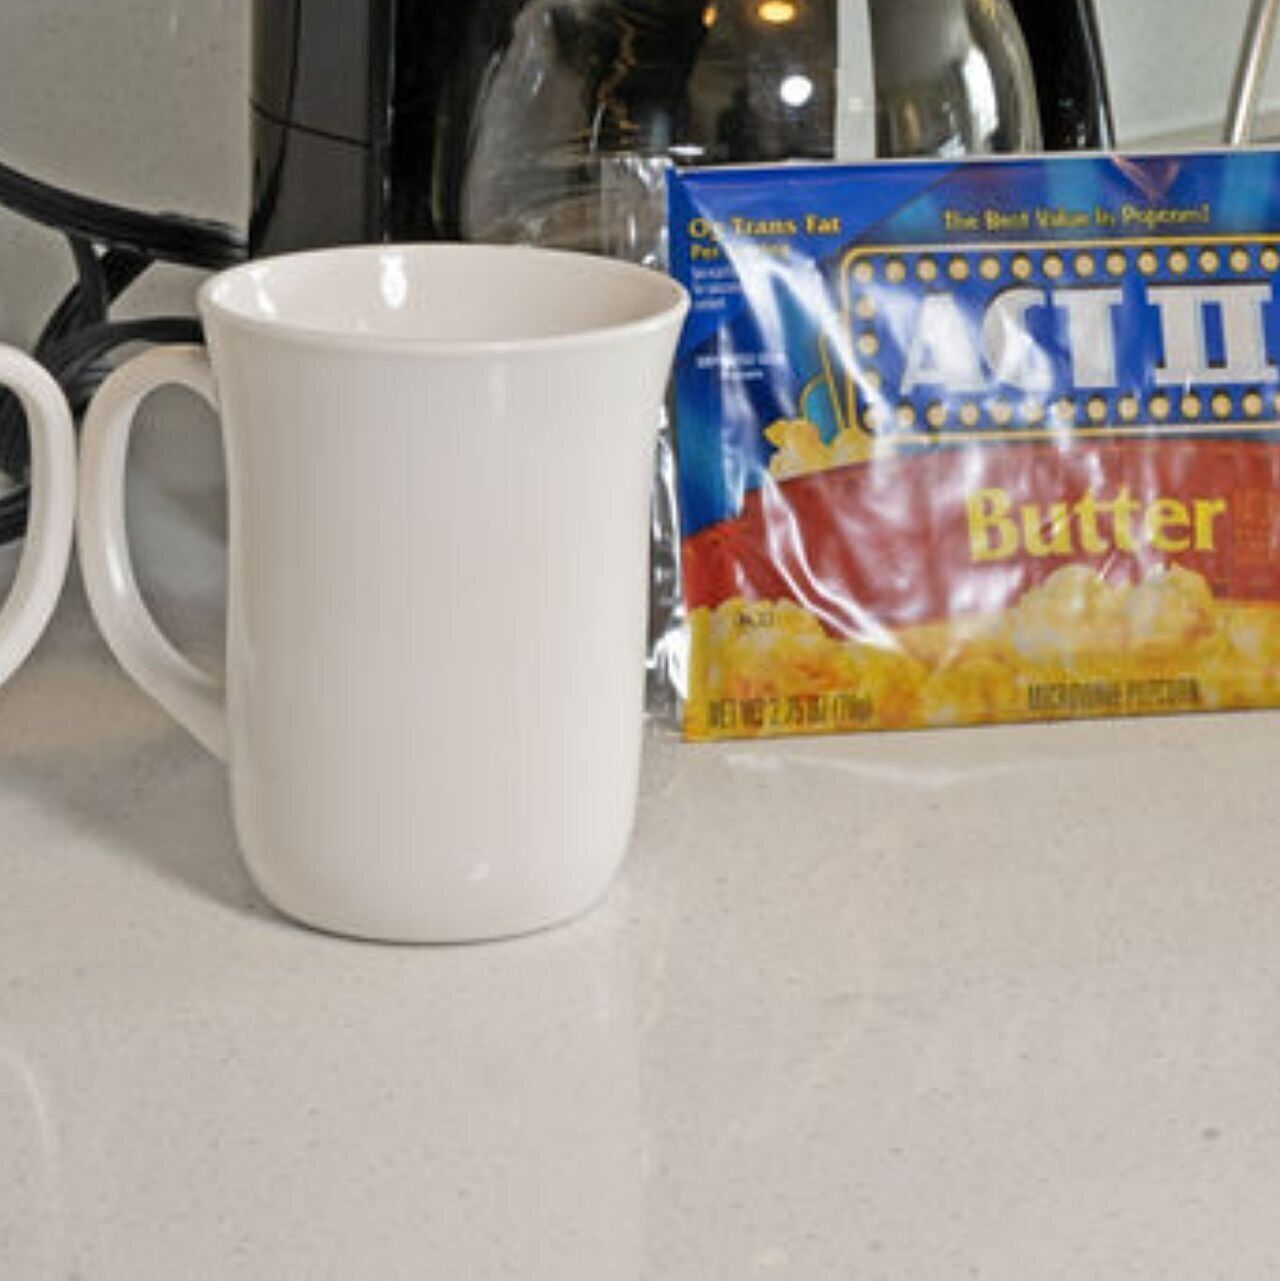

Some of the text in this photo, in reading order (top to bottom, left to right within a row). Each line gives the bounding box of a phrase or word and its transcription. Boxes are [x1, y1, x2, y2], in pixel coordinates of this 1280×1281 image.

[731, 217, 797, 234] Trans
[805, 214, 842, 234] Fat
[944, 209, 978, 231] The
[985, 208, 1029, 231] Best
[1035, 204, 1090, 228] Value
[1122, 202, 1210, 230] Popcorn!
[690, 245, 718, 261] Per
[900, 283, 1280, 395] ACT II
[965, 486, 1227, 563] Butter
[1125, 676, 1202, 706] POPCORN
[708, 697, 737, 728] NET
